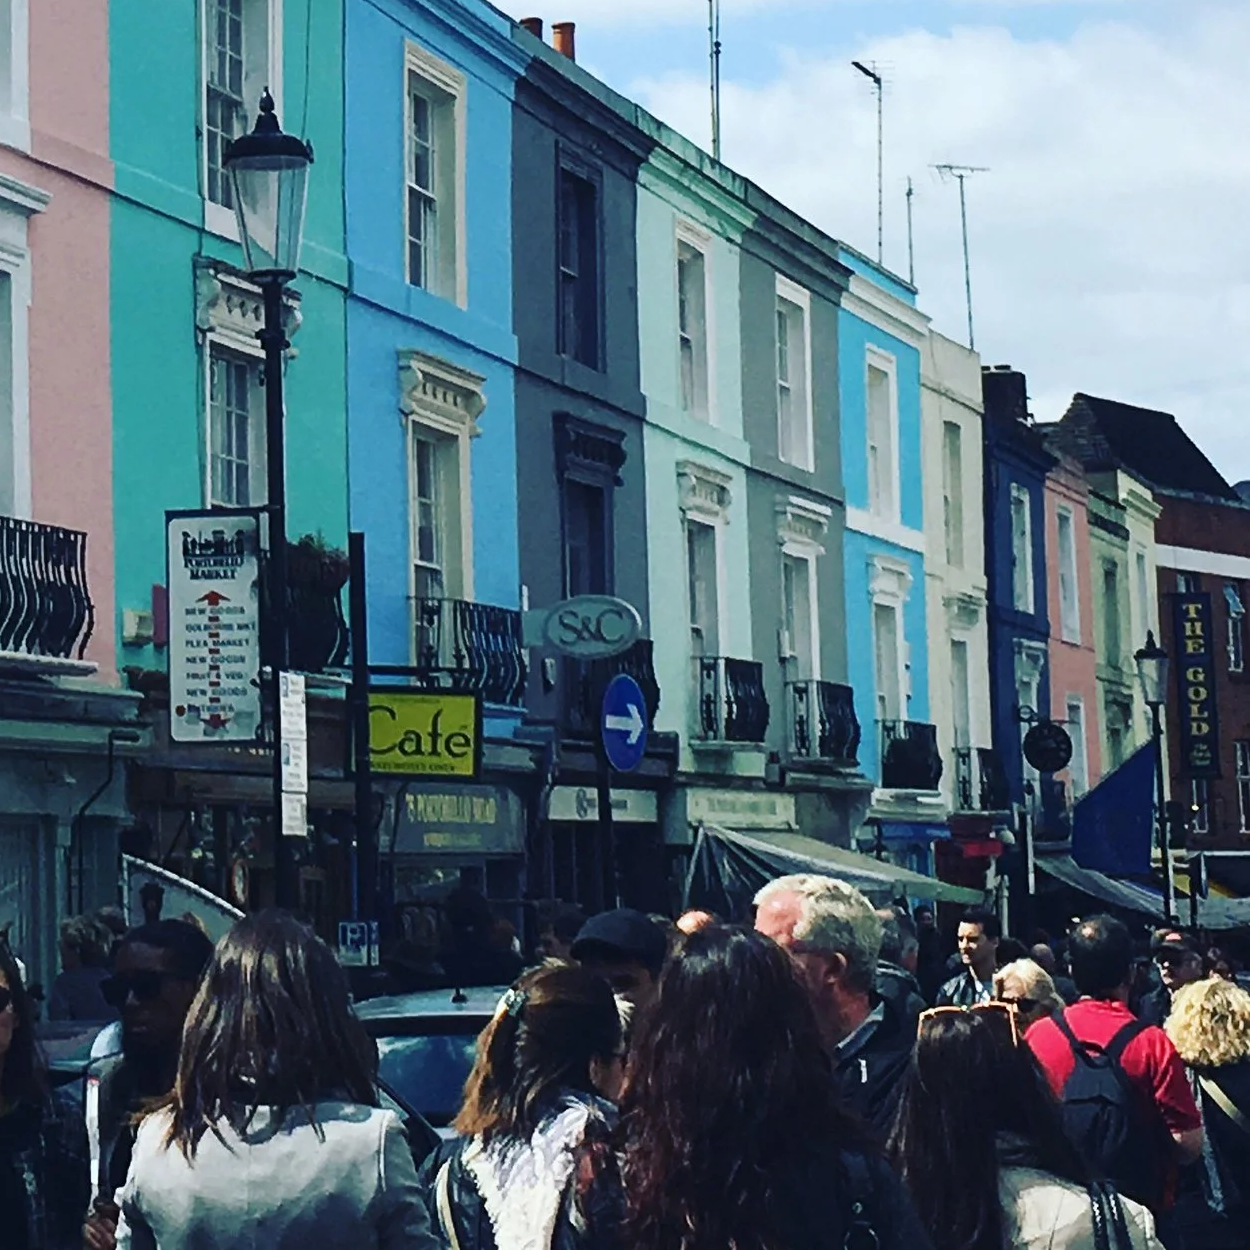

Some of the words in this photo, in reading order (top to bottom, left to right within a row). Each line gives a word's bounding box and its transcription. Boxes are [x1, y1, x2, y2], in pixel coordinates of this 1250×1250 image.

[558, 607, 625, 645] S&C
[1181, 603, 1206, 654] THE
[1185, 666, 1211, 736] GOLD
